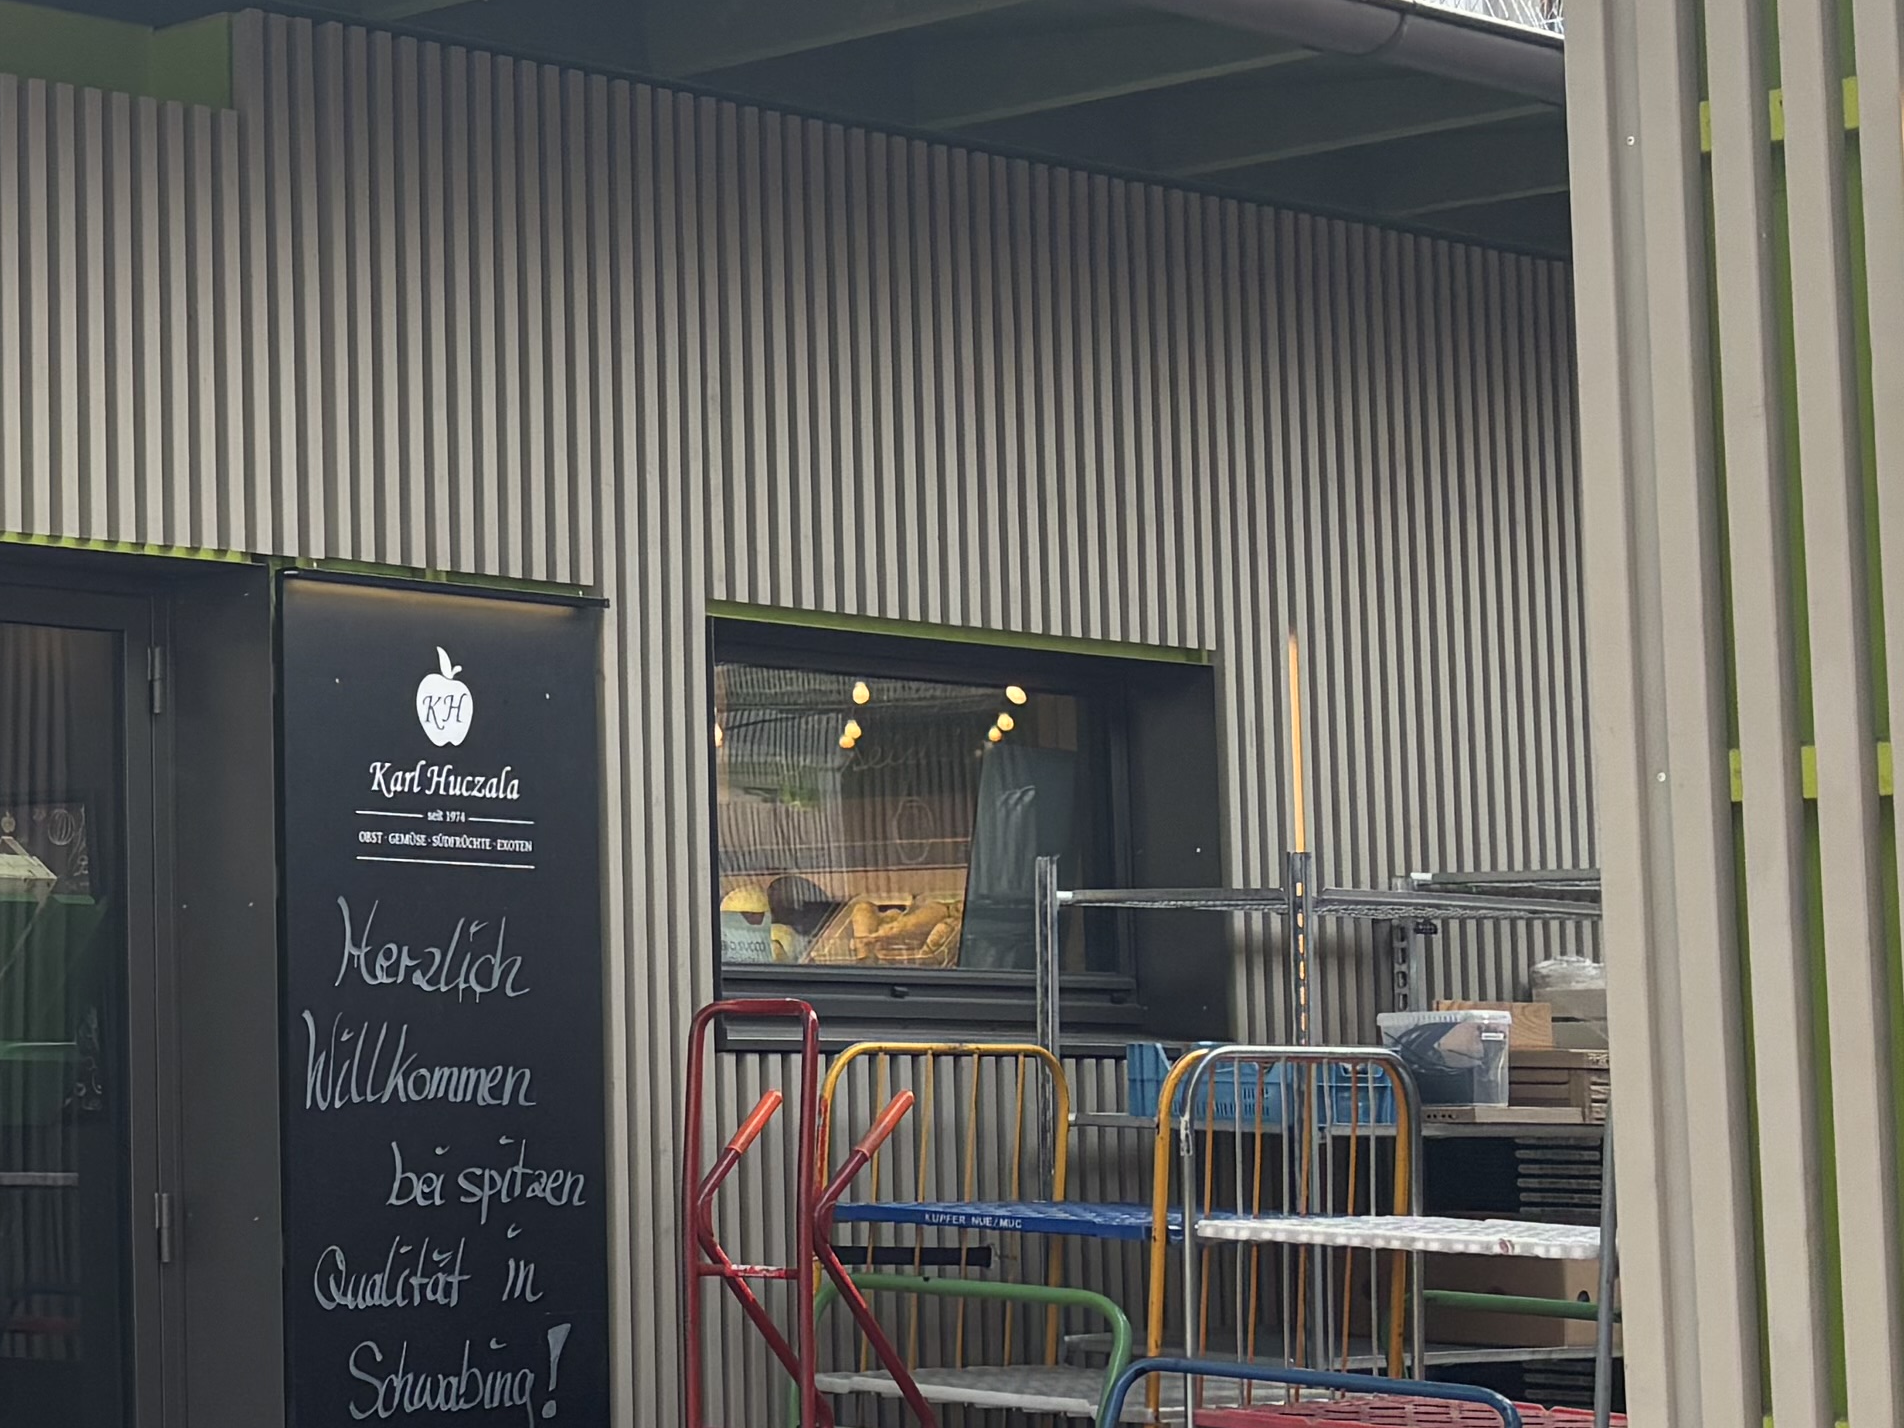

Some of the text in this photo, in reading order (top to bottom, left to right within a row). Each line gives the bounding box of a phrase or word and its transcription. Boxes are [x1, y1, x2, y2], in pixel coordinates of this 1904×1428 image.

[422, 693, 467, 730] KH
[369, 760, 520, 800] Karl Huczala
[358, 830, 533, 852] OBST GEMÜSE SÜDFRÜCHTE EXOTEN
[335, 896, 531, 998] Herzlich
[302, 1010, 537, 1111] Willkommen
[386, 1135, 587, 1226] bei spitzen
[313, 1223, 543, 1311] Qualität in
